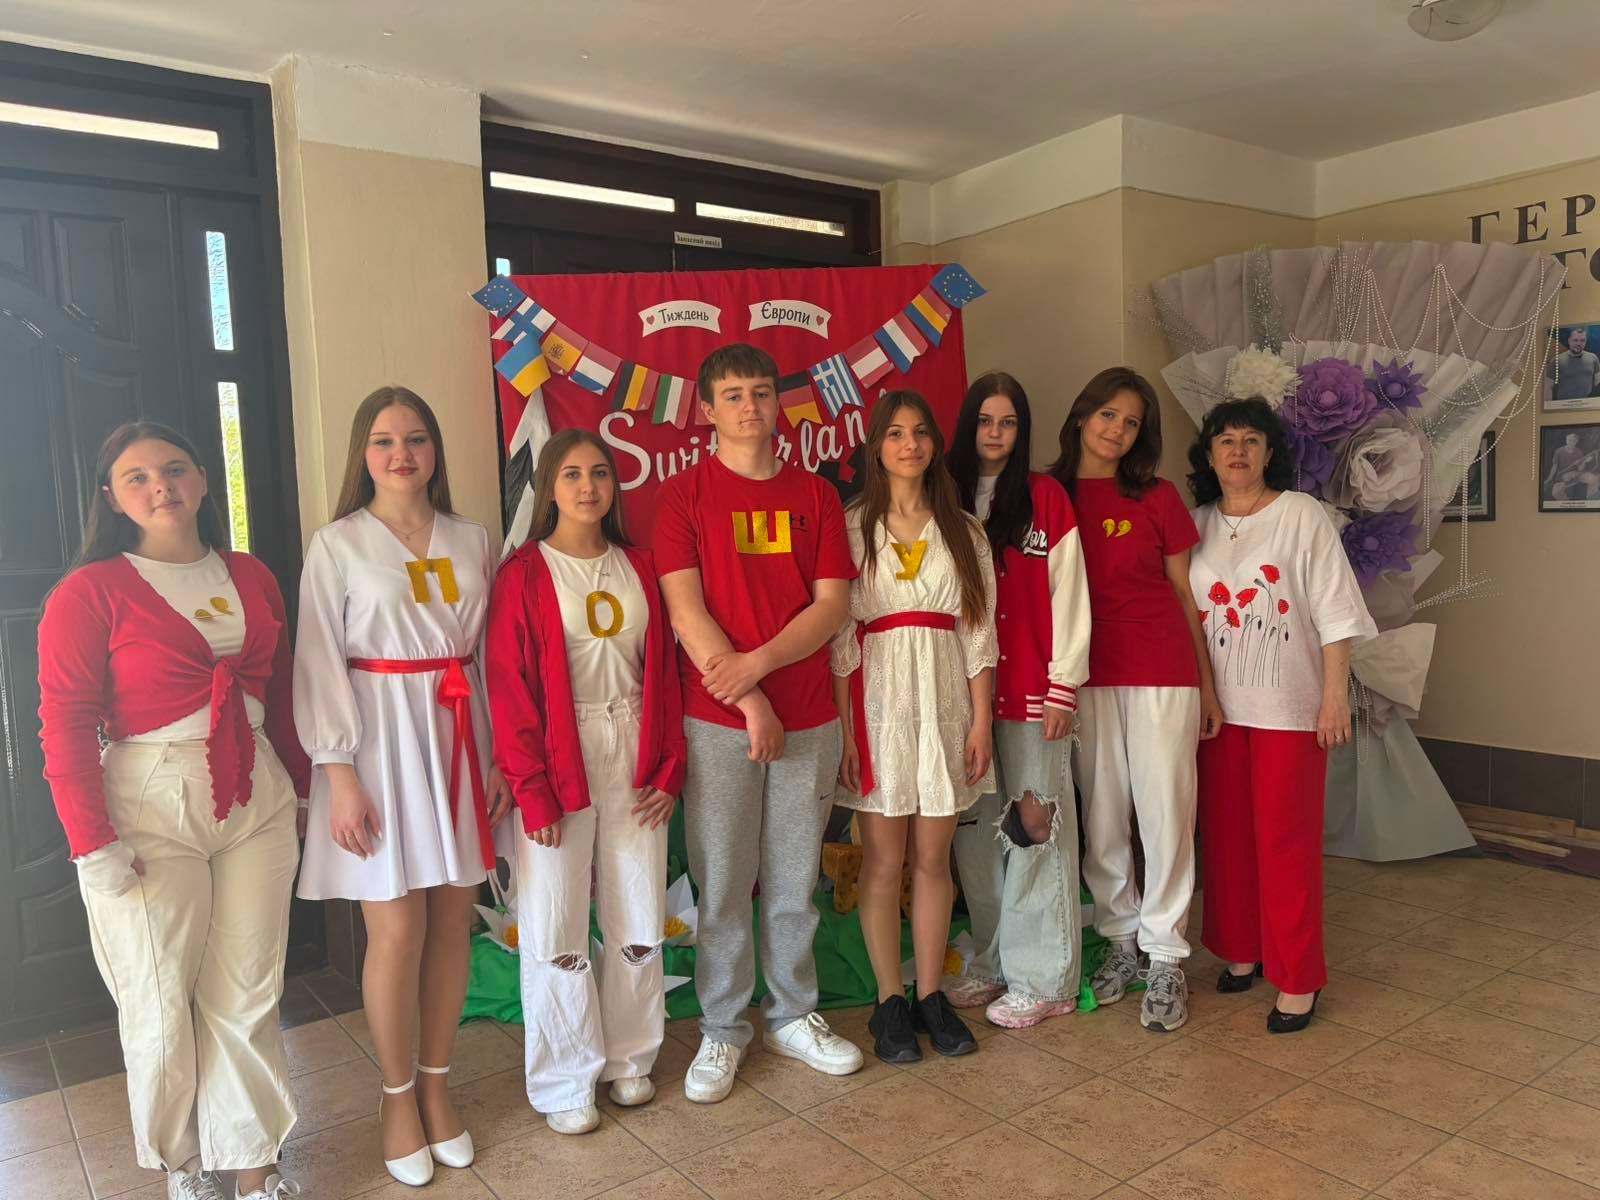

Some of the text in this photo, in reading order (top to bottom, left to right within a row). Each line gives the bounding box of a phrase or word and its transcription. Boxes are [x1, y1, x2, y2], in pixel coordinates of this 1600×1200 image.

[658, 301, 811, 326] Тиждень Європи
[731, 510, 792, 555] Ш
[405, 557, 460, 604] П
[890, 540, 928, 581] У
[586, 590, 625, 638] О
